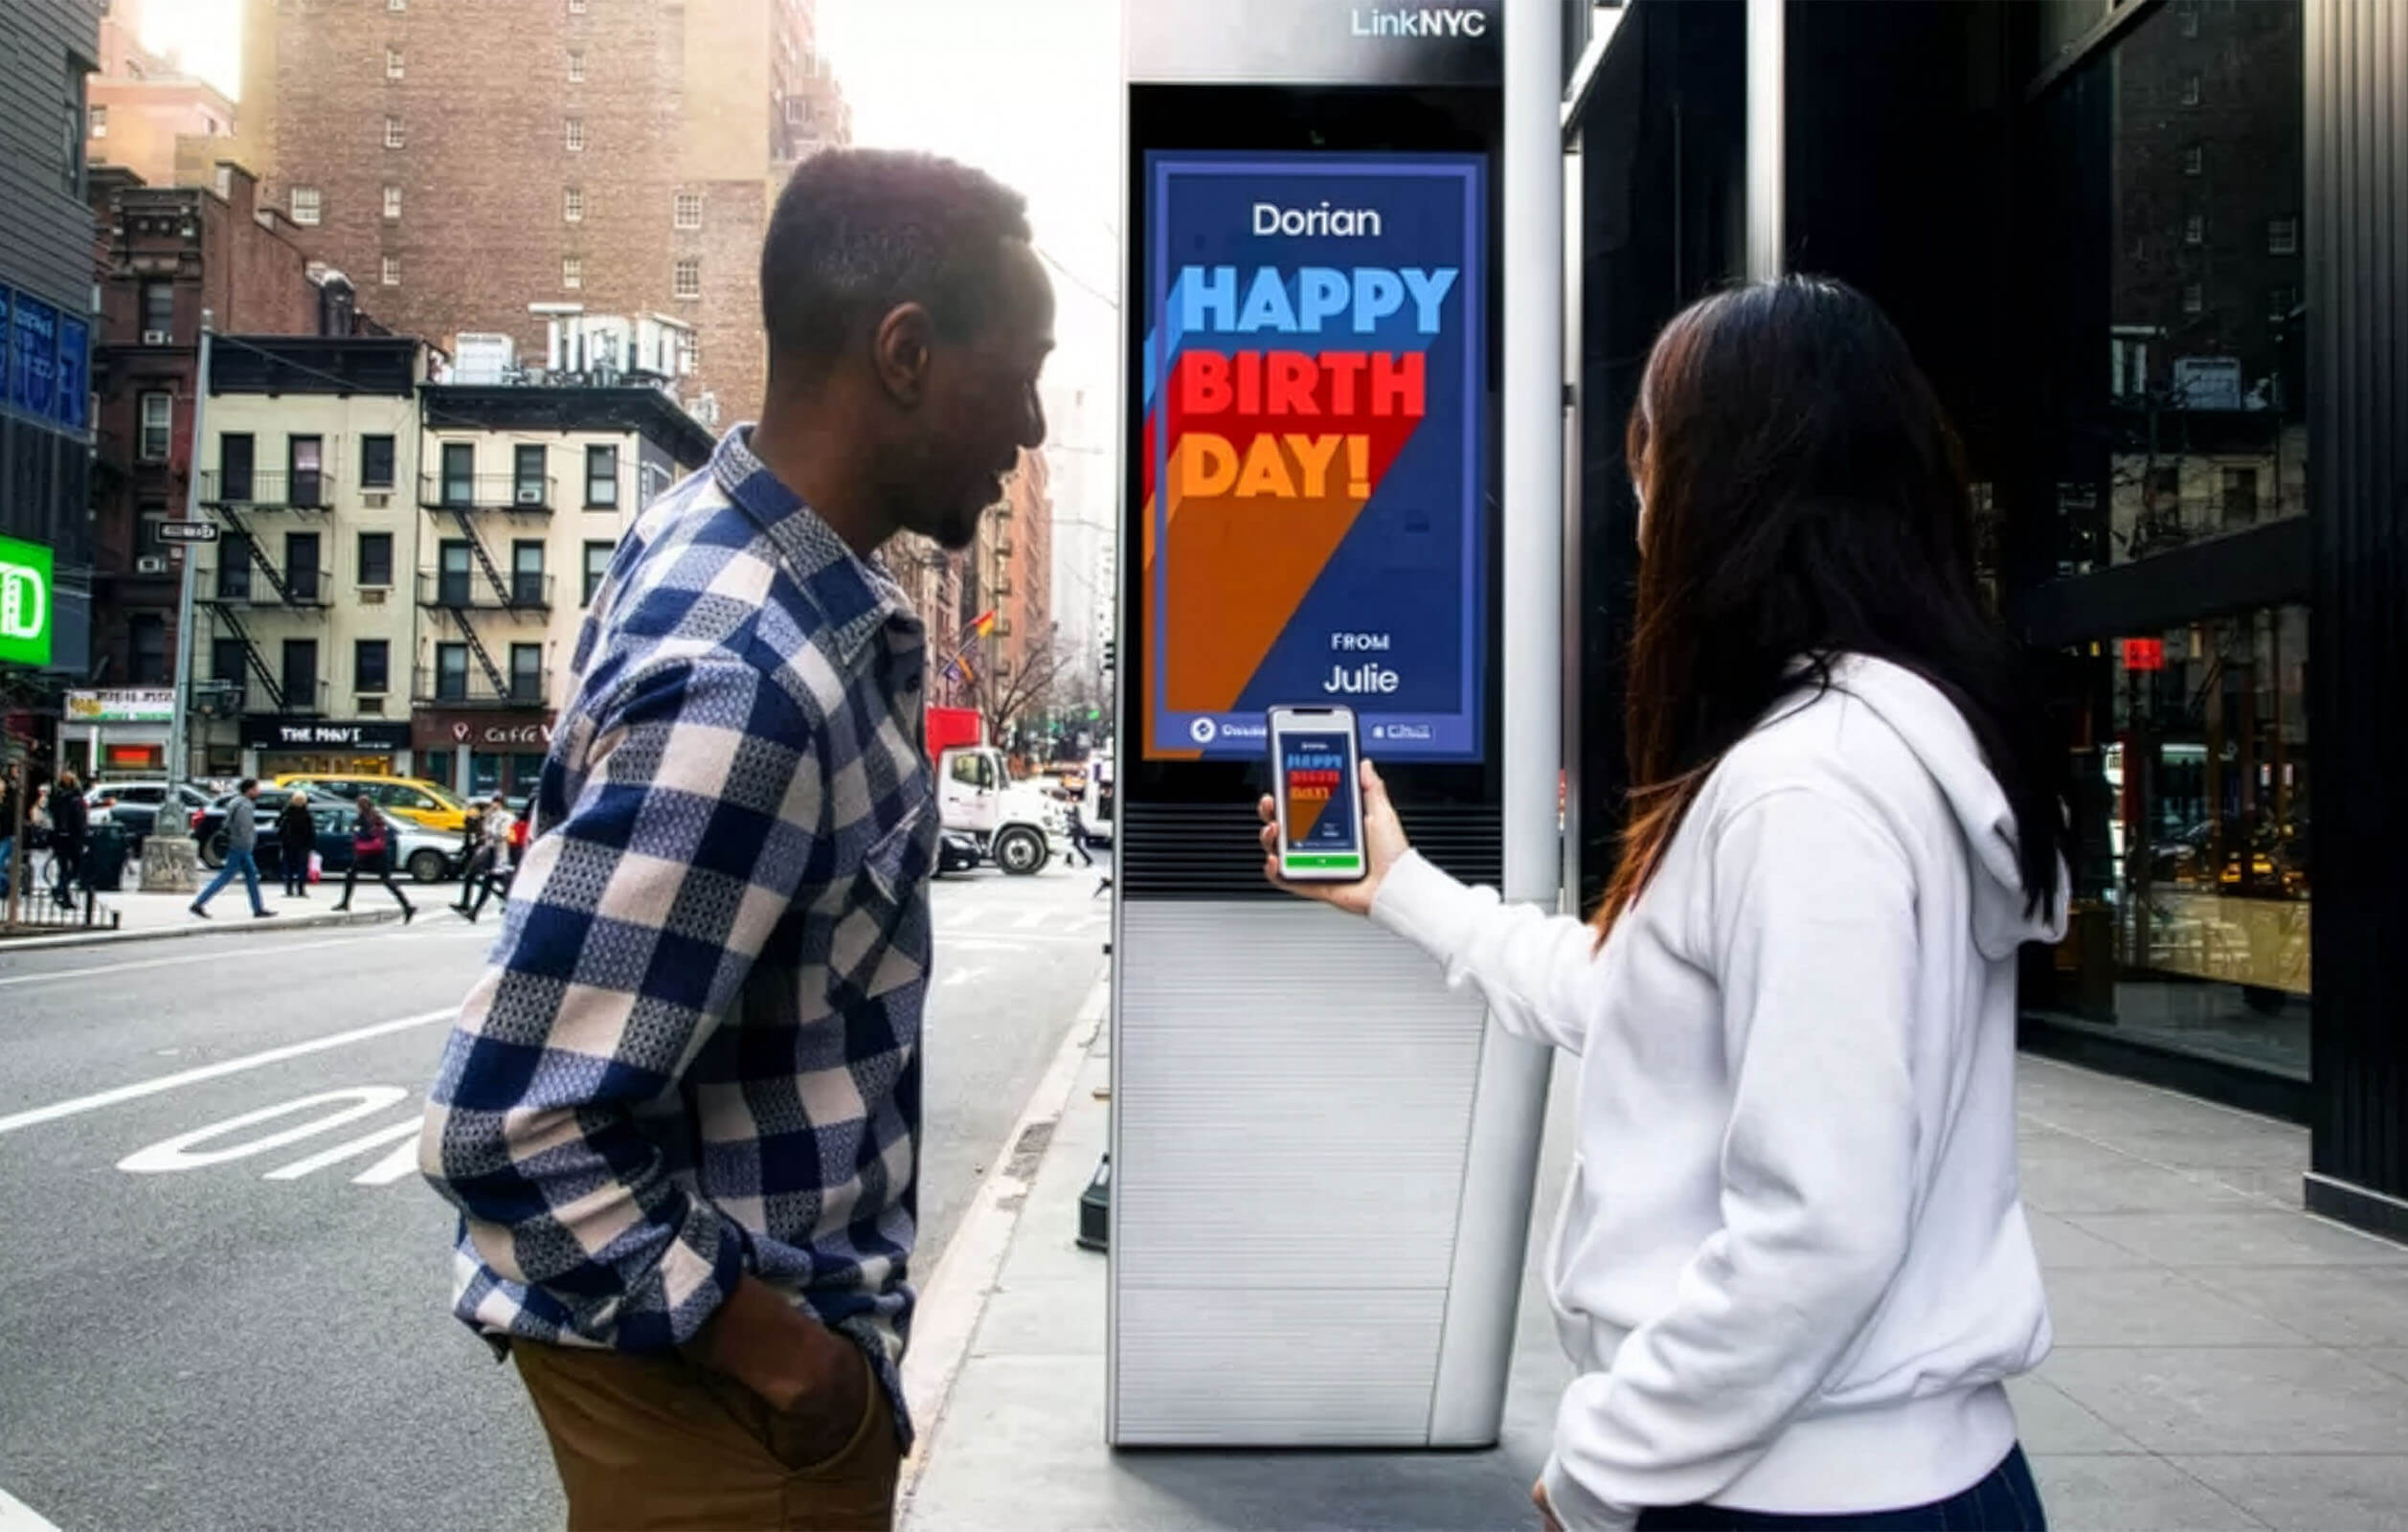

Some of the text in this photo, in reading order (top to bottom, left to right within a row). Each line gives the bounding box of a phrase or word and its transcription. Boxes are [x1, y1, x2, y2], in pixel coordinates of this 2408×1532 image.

[1351, 9, 1486, 36] LinkNYC
[1252, 201, 1382, 237] Dorian
[1181, 265, 1459, 334] HAPPY
[1181, 350, 1426, 417] BIRTH
[1181, 433, 1371, 499] DAY!
[1331, 633, 1390, 650] FROM
[1324, 663, 1399, 693] Julie
[280, 727, 312, 742] THE
